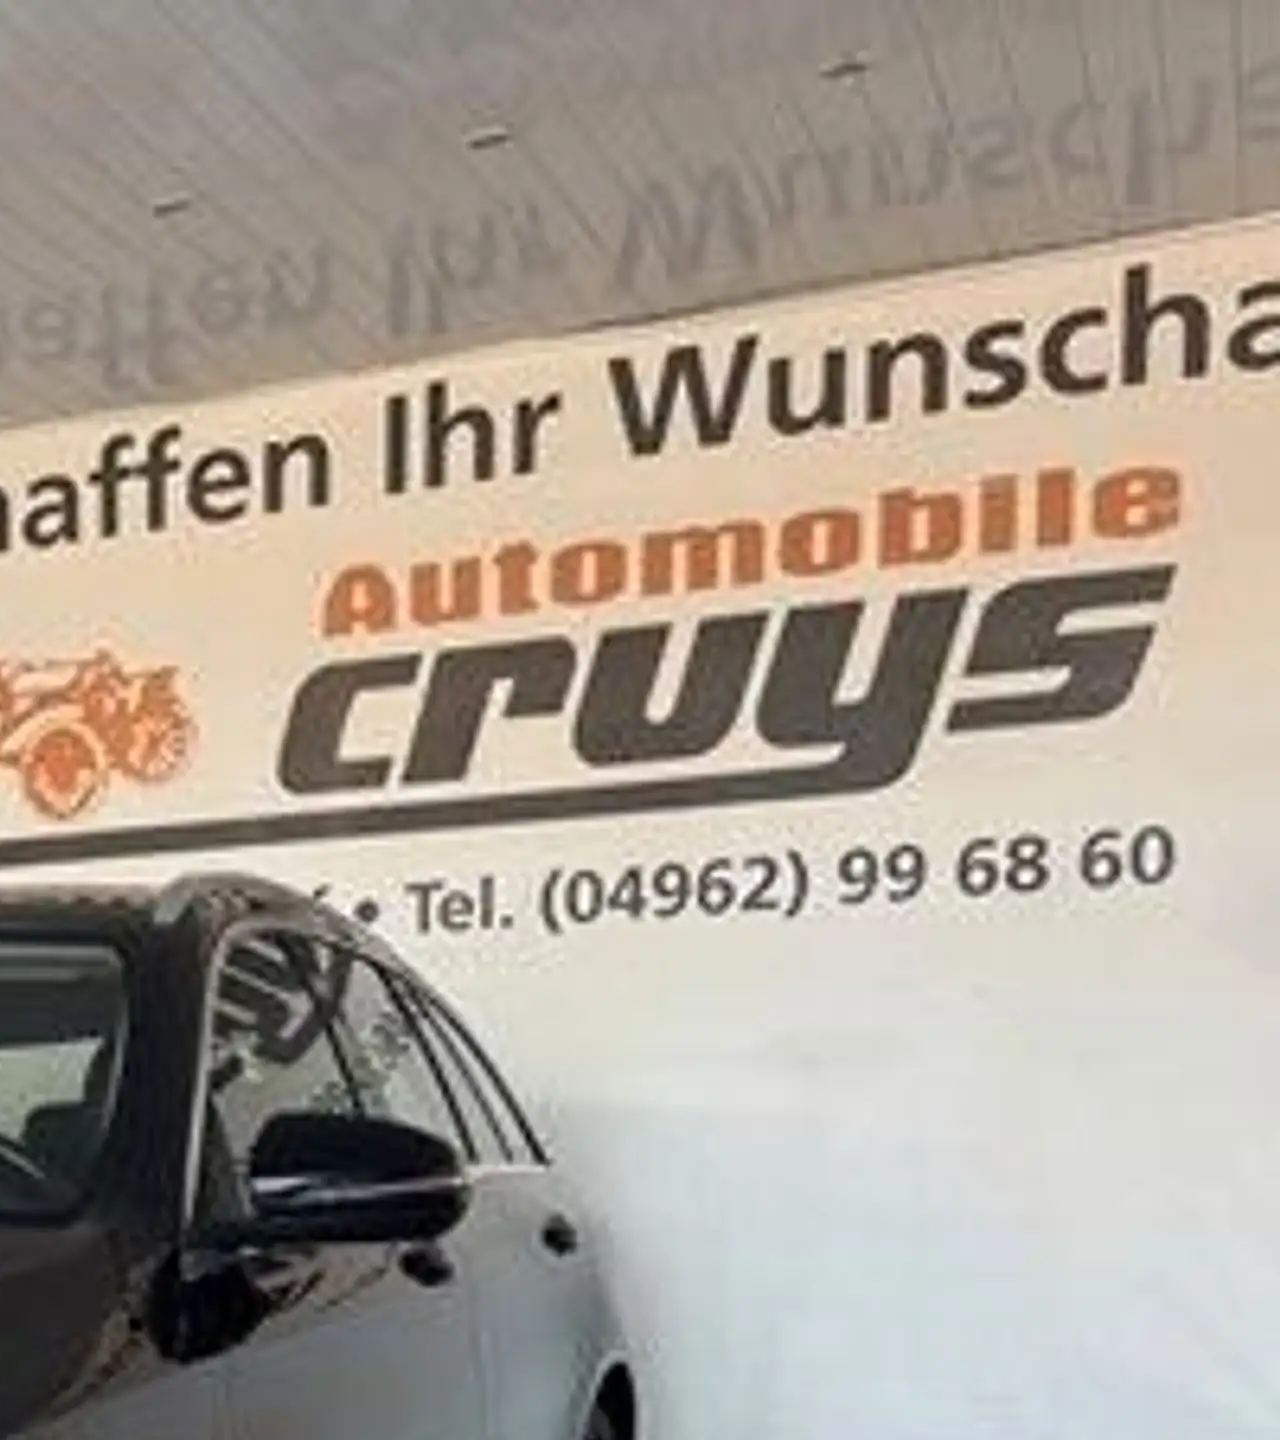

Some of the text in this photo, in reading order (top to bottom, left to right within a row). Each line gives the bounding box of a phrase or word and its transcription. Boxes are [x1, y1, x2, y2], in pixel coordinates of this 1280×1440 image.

[383, 378, 564, 496] Ihr
[320, 464, 1184, 637] Automobile
[403, 823, 1177, 937] Tel. (04962) 99 68 60
